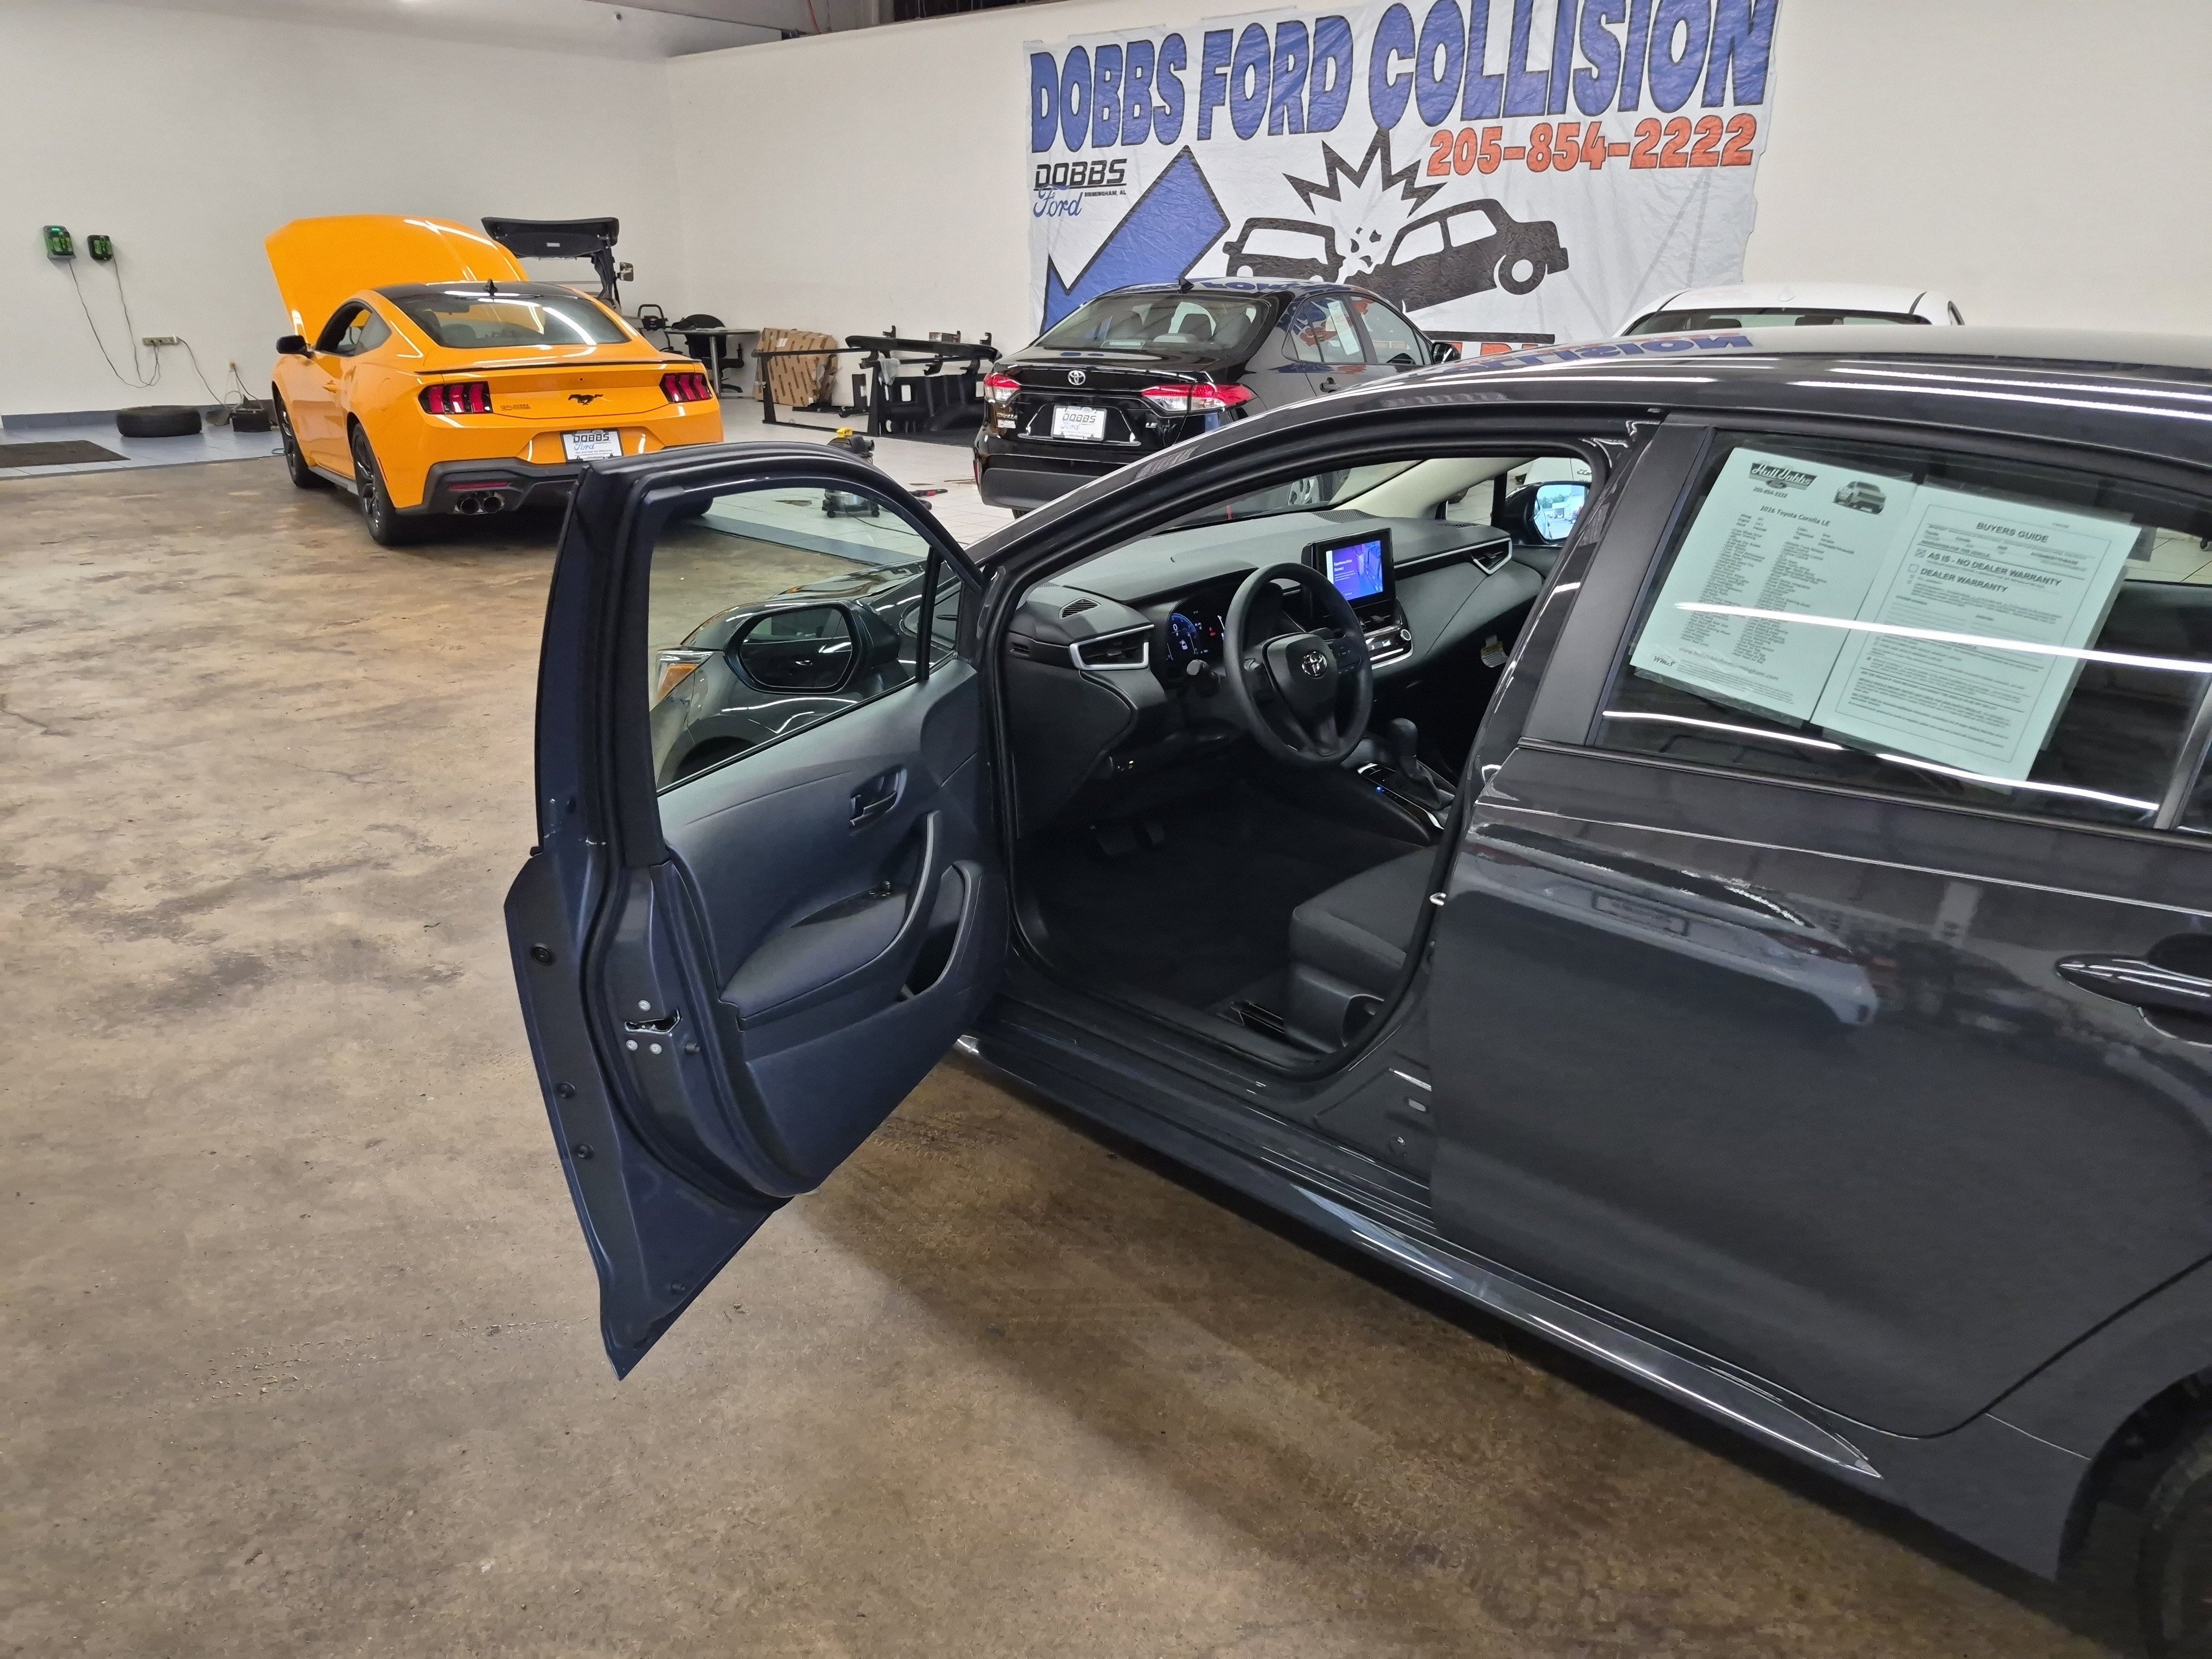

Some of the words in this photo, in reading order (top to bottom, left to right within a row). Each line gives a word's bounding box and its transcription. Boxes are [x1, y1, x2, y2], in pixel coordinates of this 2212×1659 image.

[1030, 33, 1187, 153] DOBBS
[1197, 15, 1354, 141] FORD
[1369, 0, 1779, 131] COLLISION
[1426, 113, 1757, 177] 205-854-2222
[1035, 158, 1127, 188] DOBBS
[1033, 183, 1083, 218] Ford
[1063, 413, 1097, 422] DOBBS
[573, 434, 609, 442] DOBBS
[574, 442, 595, 451] Ford
[1777, 509, 1797, 519] Toyota
[1798, 514, 1821, 525] Corolla
[1976, 522, 2016, 536] BUYERS
[2017, 530, 2049, 543] GUIDE
[1920, 568, 1956, 581] DEALER
[1956, 575, 2008, 593] WARRANTY
[1927, 552, 1940, 561] AS
[1956, 558, 1970, 567] NO
[1971, 561, 2008, 575] DEALER
[2009, 569, 2061, 586] WARRANTY
